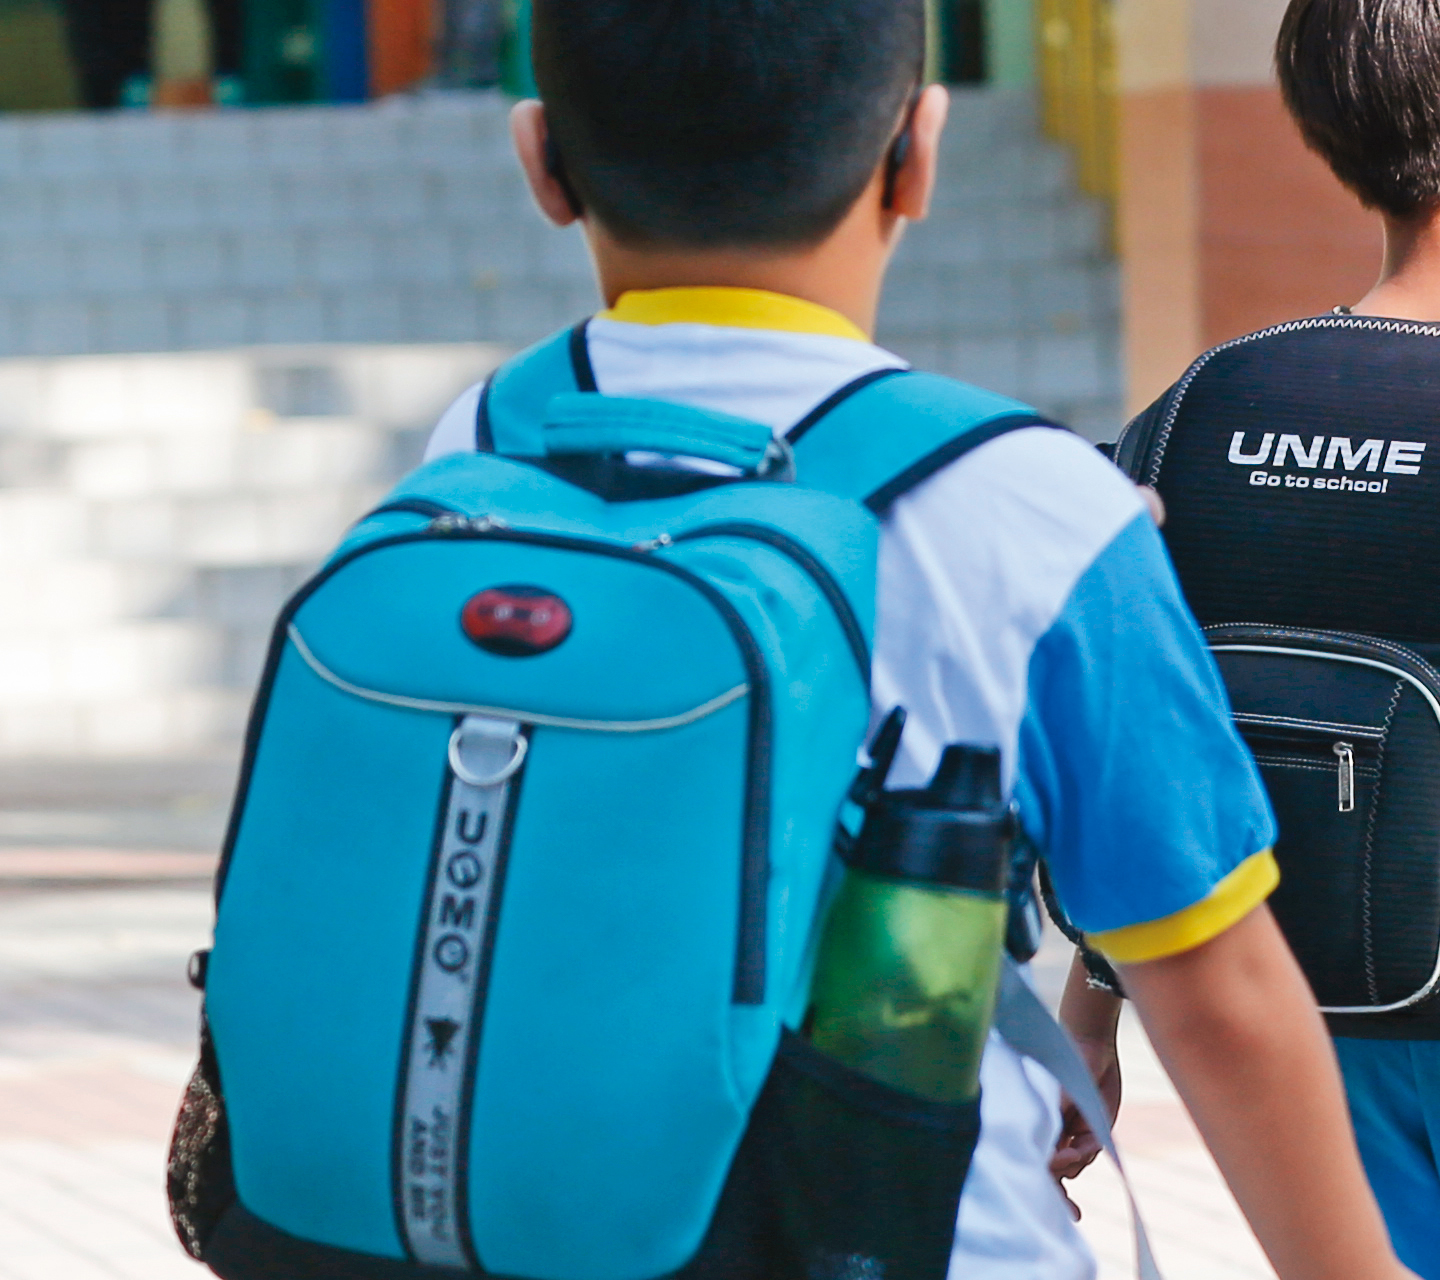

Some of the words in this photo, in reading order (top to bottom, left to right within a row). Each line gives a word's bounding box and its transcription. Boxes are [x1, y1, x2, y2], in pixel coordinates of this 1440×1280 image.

[1227, 431, 1427, 475] UNME
[1249, 471, 1281, 487] Go
[1284, 474, 1310, 488] to
[1312, 476, 1388, 493] school
[433, 808, 488, 972] UOMO
